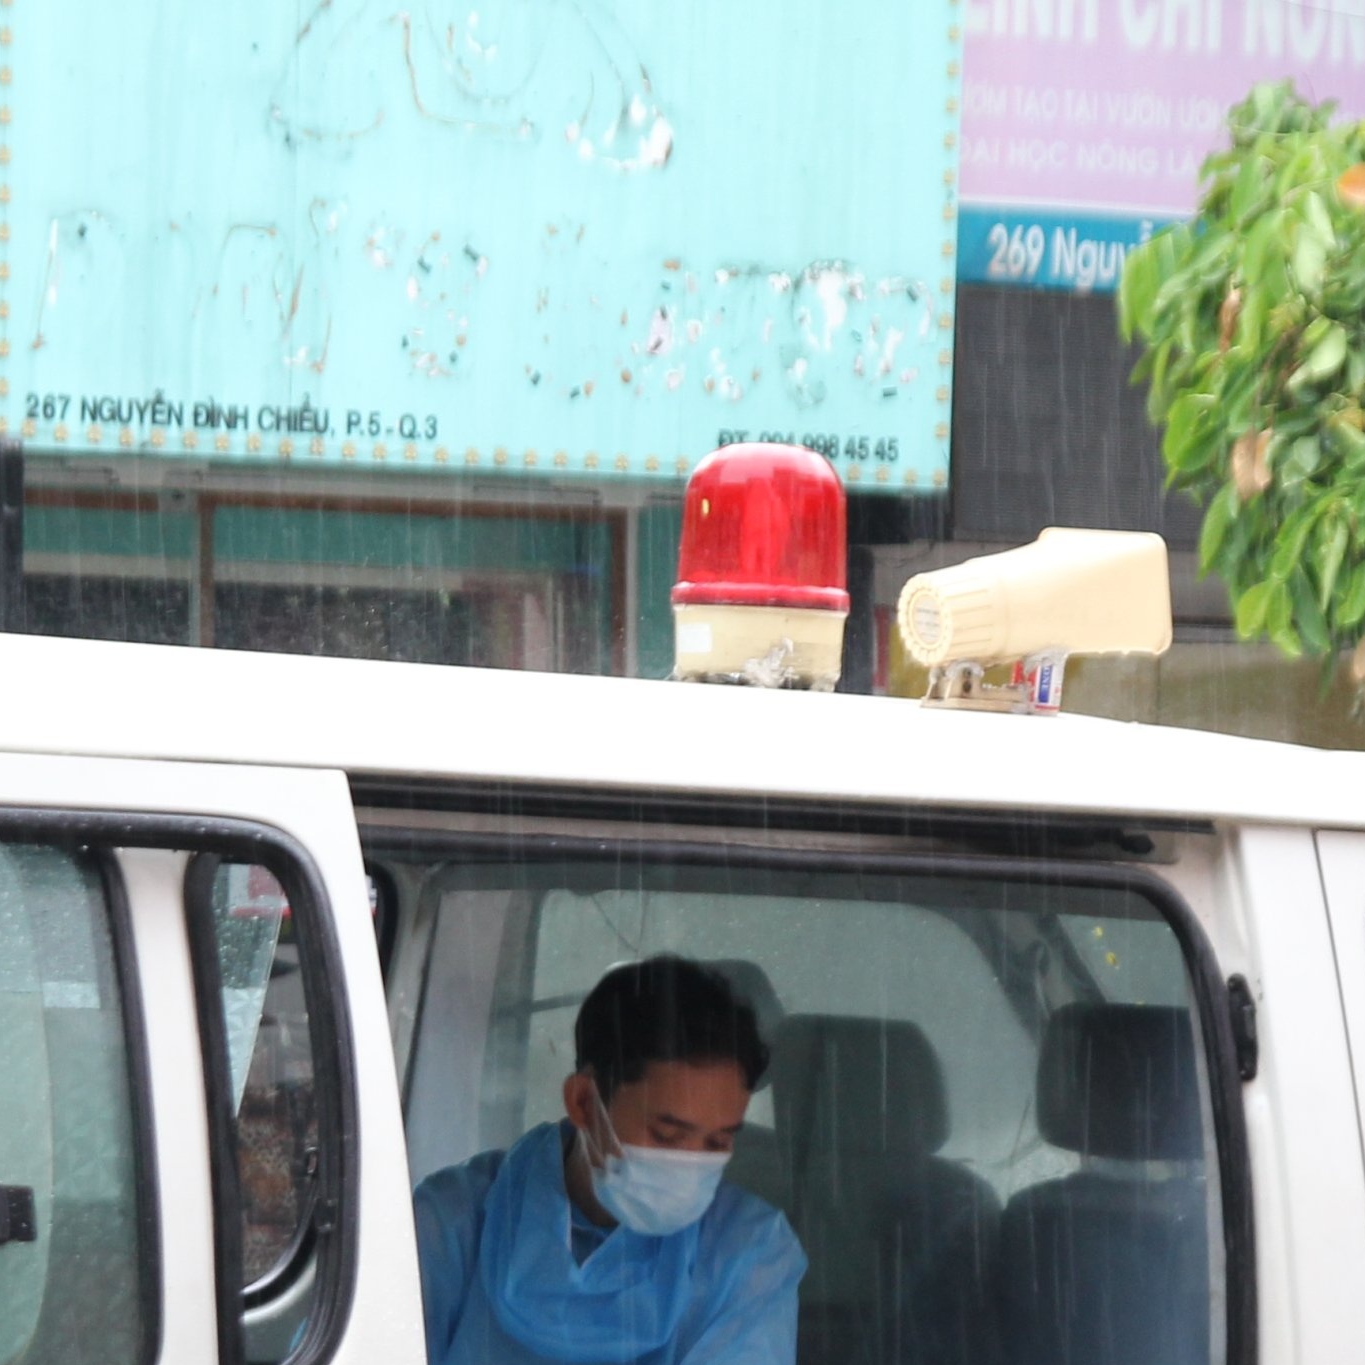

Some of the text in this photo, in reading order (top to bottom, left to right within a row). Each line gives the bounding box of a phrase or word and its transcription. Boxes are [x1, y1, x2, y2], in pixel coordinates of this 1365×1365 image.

[988, 222, 1046, 281] 269
[26, 395, 72, 420] 267
[845, 436, 870, 460] 45
[874, 438, 899, 462] 45
